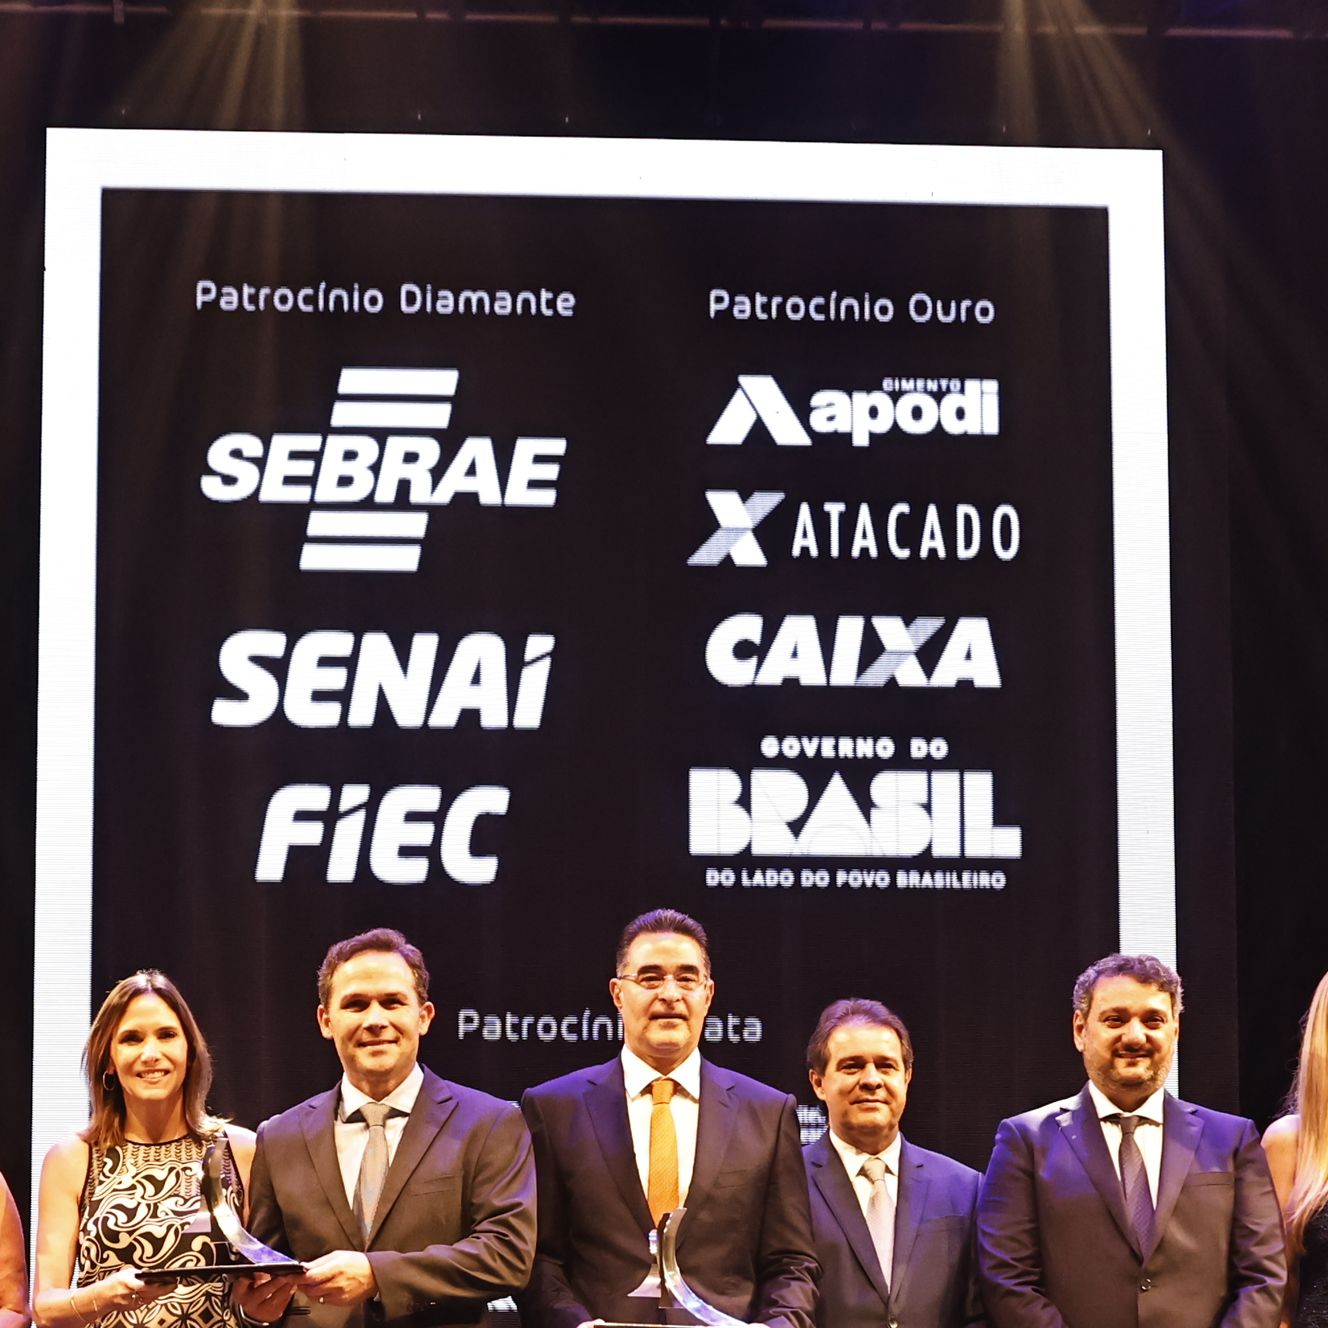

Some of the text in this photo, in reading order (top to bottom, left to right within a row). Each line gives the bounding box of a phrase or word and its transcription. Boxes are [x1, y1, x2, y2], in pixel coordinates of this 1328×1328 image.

[196, 280, 576, 316] Patrocínio Diamante
[710, 289, 995, 324] Patrocínio Ouro
[882, 377, 962, 392] CIMENTO
[809, 378, 1000, 447] apodi
[200, 432, 567, 507] SEBRAE
[792, 502, 1020, 561] ATACADO
[705, 612, 1002, 688] CAIXA
[760, 735, 949, 760] GOVERNO DO
[689, 767, 1022, 859] BRASIL
[706, 868, 1006, 890] DO LADO DO POVO BRASILEIRO
[458, 1008, 763, 1043] Patrocíni ata
